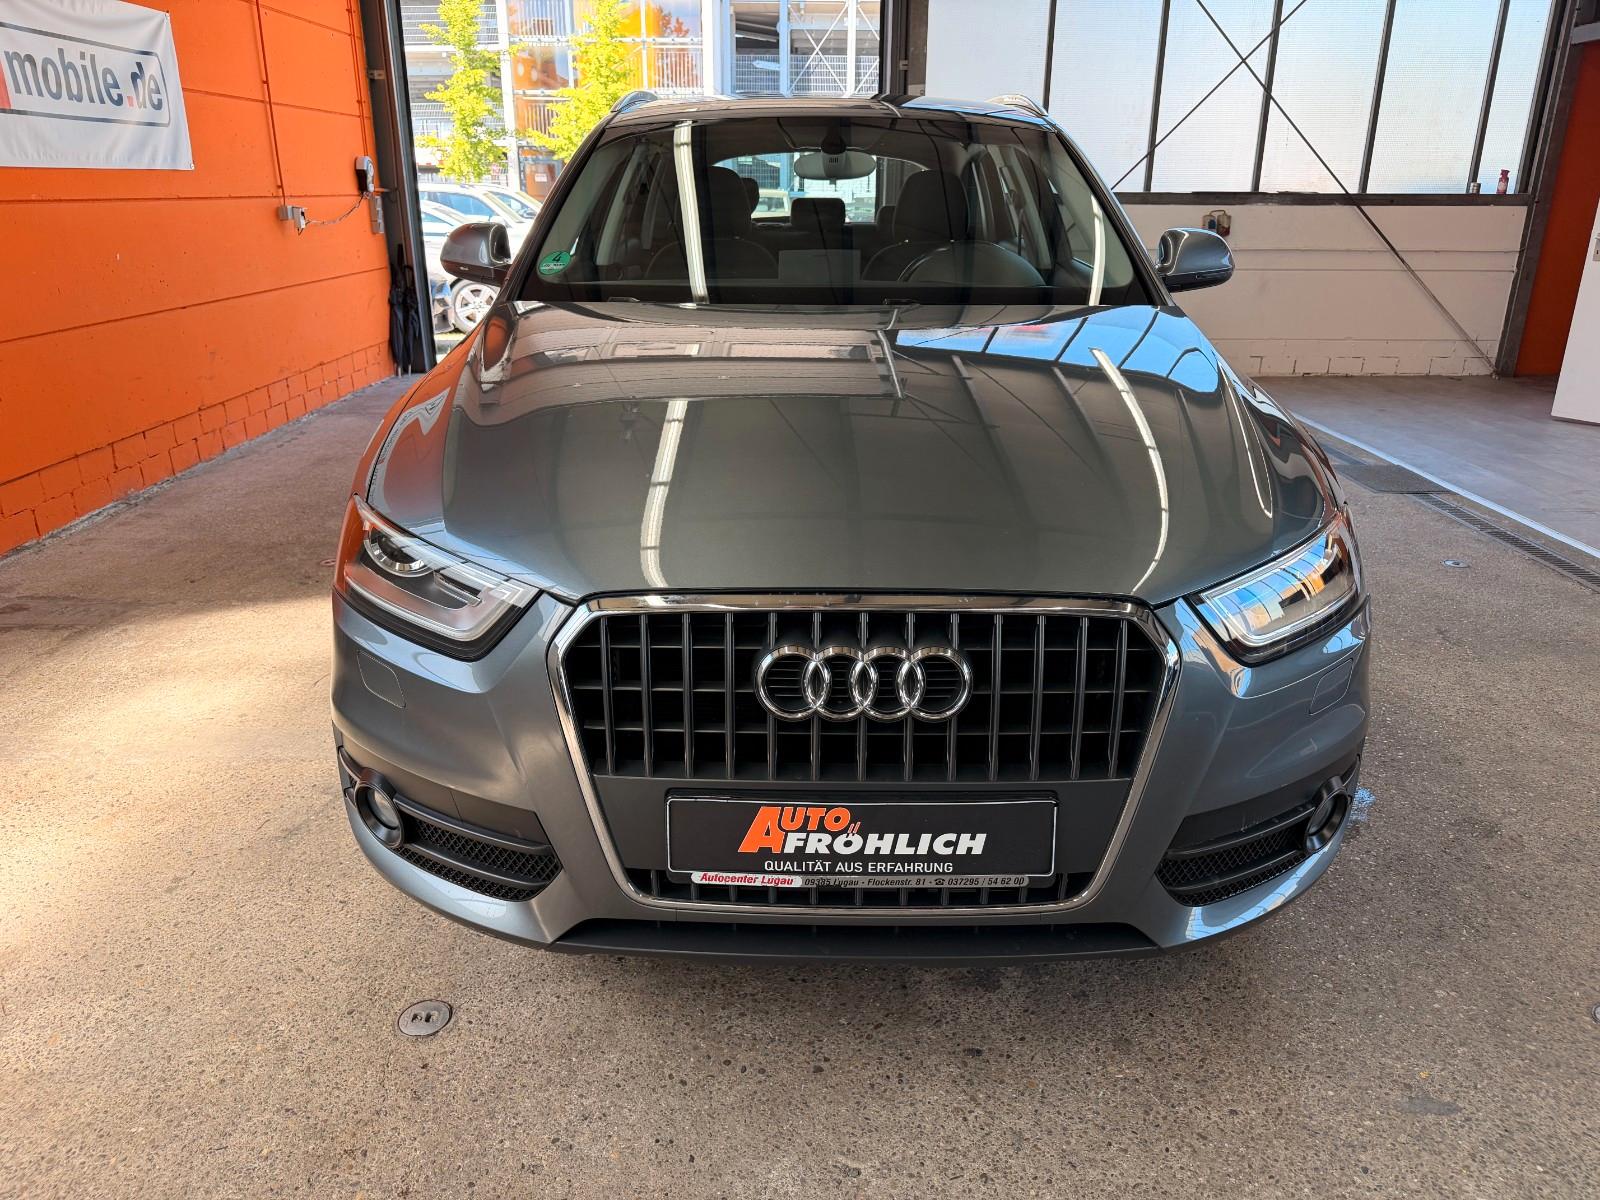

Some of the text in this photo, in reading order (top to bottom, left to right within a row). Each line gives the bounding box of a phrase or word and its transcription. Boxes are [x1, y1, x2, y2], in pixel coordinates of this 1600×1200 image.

[4, 48, 163, 111] mobile.de
[738, 806, 851, 854] AUTO
[783, 822, 987, 855] FRÖHLICH
[764, 860, 954, 873] QUALITÄT AUS ERFAHRUNG
[700, 872, 794, 886] Autocenter Lugau
[867, 877, 913, 887] Flockenstr.
[915, 878, 926, 886] 81
[947, 877, 980, 886] 037295
[987, 877, 998, 885] 54
